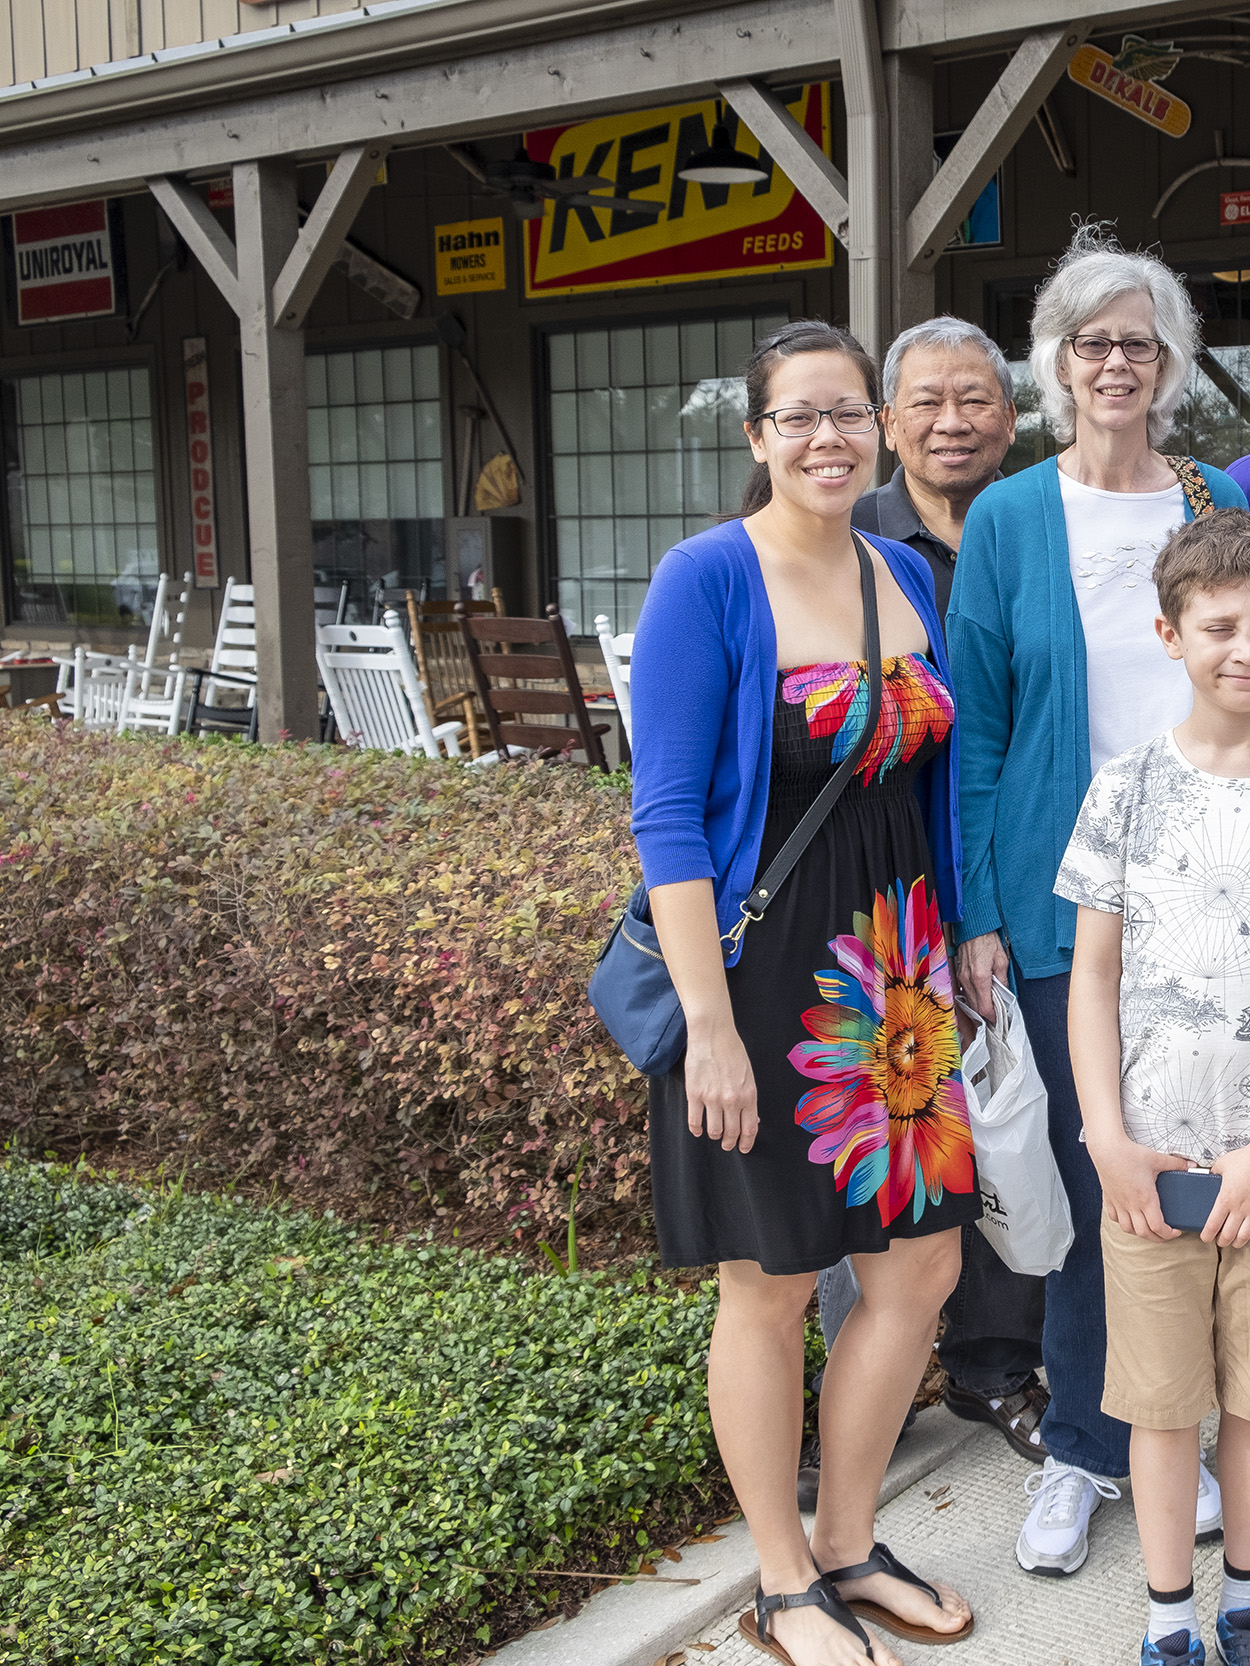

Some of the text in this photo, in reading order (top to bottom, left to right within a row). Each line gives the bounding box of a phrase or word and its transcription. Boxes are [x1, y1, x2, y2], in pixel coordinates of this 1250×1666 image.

[438, 230, 500, 252] Hahn
[742, 231, 803, 255] FEEDS
[18, 239, 108, 281] UNIROYAL
[449, 253, 486, 270] MOWERS
